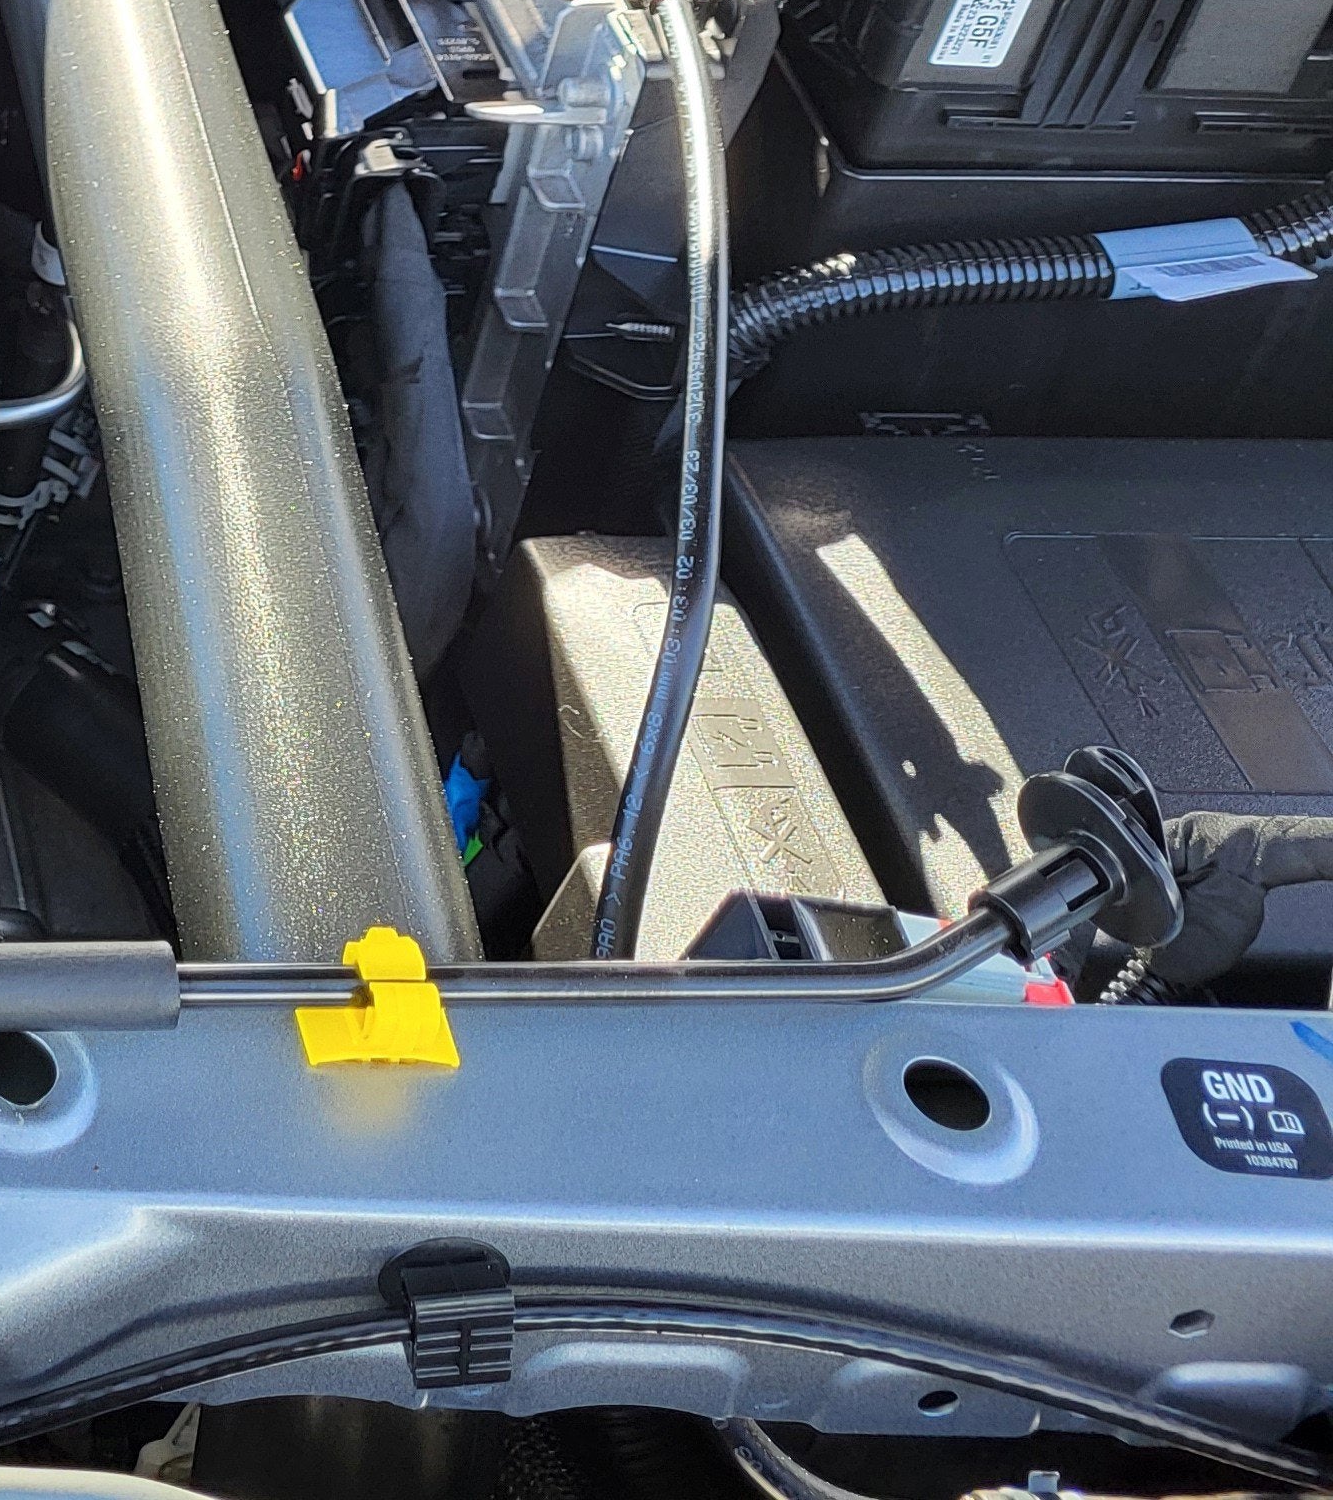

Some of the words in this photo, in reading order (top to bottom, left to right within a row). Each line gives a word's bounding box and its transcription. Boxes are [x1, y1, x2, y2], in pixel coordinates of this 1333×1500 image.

[969, 15, 998, 48] G5F
[655, 669, 673, 701] mm
[679, 449, 702, 543] 03/03/23
[1201, 1070, 1275, 1104] GND
[1213, 1135, 1255, 1152] Printed
[1255, 1139, 1269, 1153] in
[1267, 1140, 1294, 1155] USA
